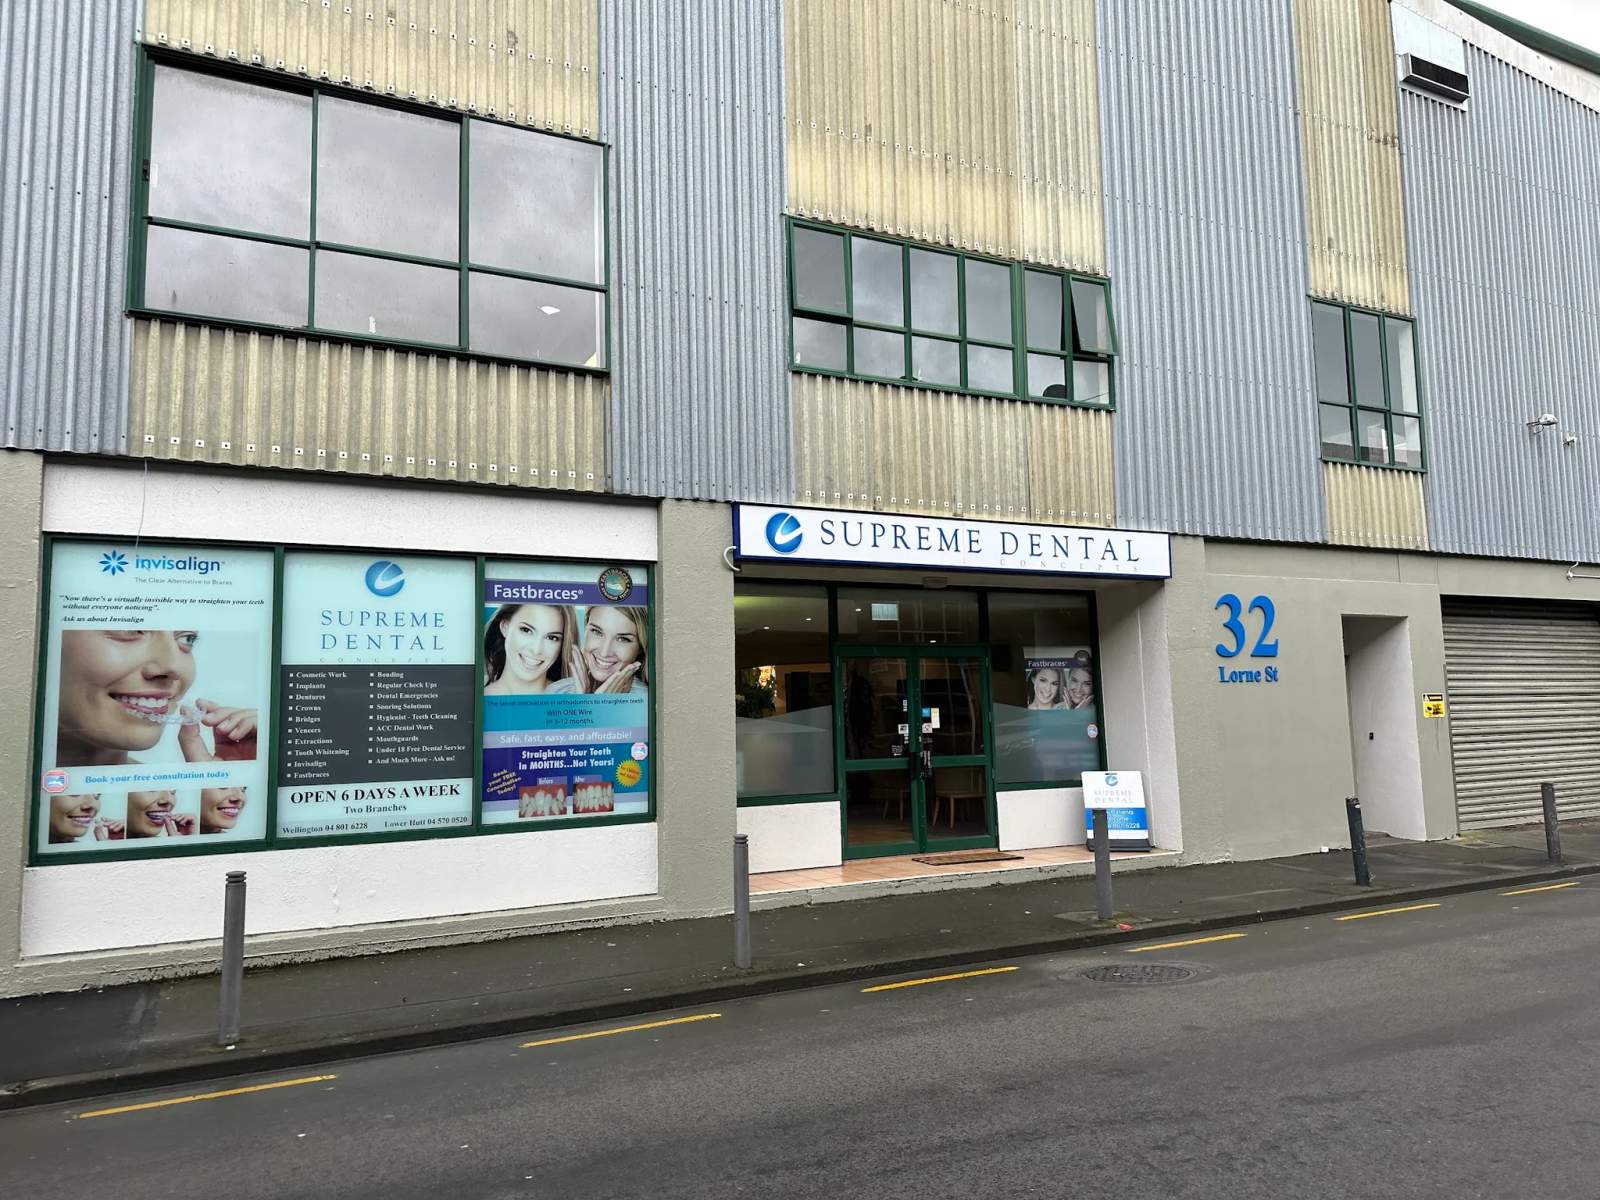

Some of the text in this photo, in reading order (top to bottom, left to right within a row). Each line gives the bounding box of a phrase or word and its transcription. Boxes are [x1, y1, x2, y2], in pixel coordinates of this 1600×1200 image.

[820, 520, 1139, 562] SUPREME DENTAL
[321, 609, 446, 628] SUPREME
[1215, 592, 1279, 658] 32
[322, 634, 444, 650] DENTAL
[1218, 666, 1278, 683] Lorne St
[500, 735, 522, 744] Safe,
[524, 734, 542, 743] fast,
[569, 732, 585, 740] and
[587, 731, 632, 740] affordable!
[521, 747, 611, 760] Straighten Your Teeth
[589, 758, 614, 767] Years!
[110, 776, 132, 784] your
[153, 772, 204, 780] consultation
[207, 771, 229, 780] today
[290, 783, 460, 804] OPEN 6 DAYS A WEEK
[344, 804, 407, 814] Two Branches
